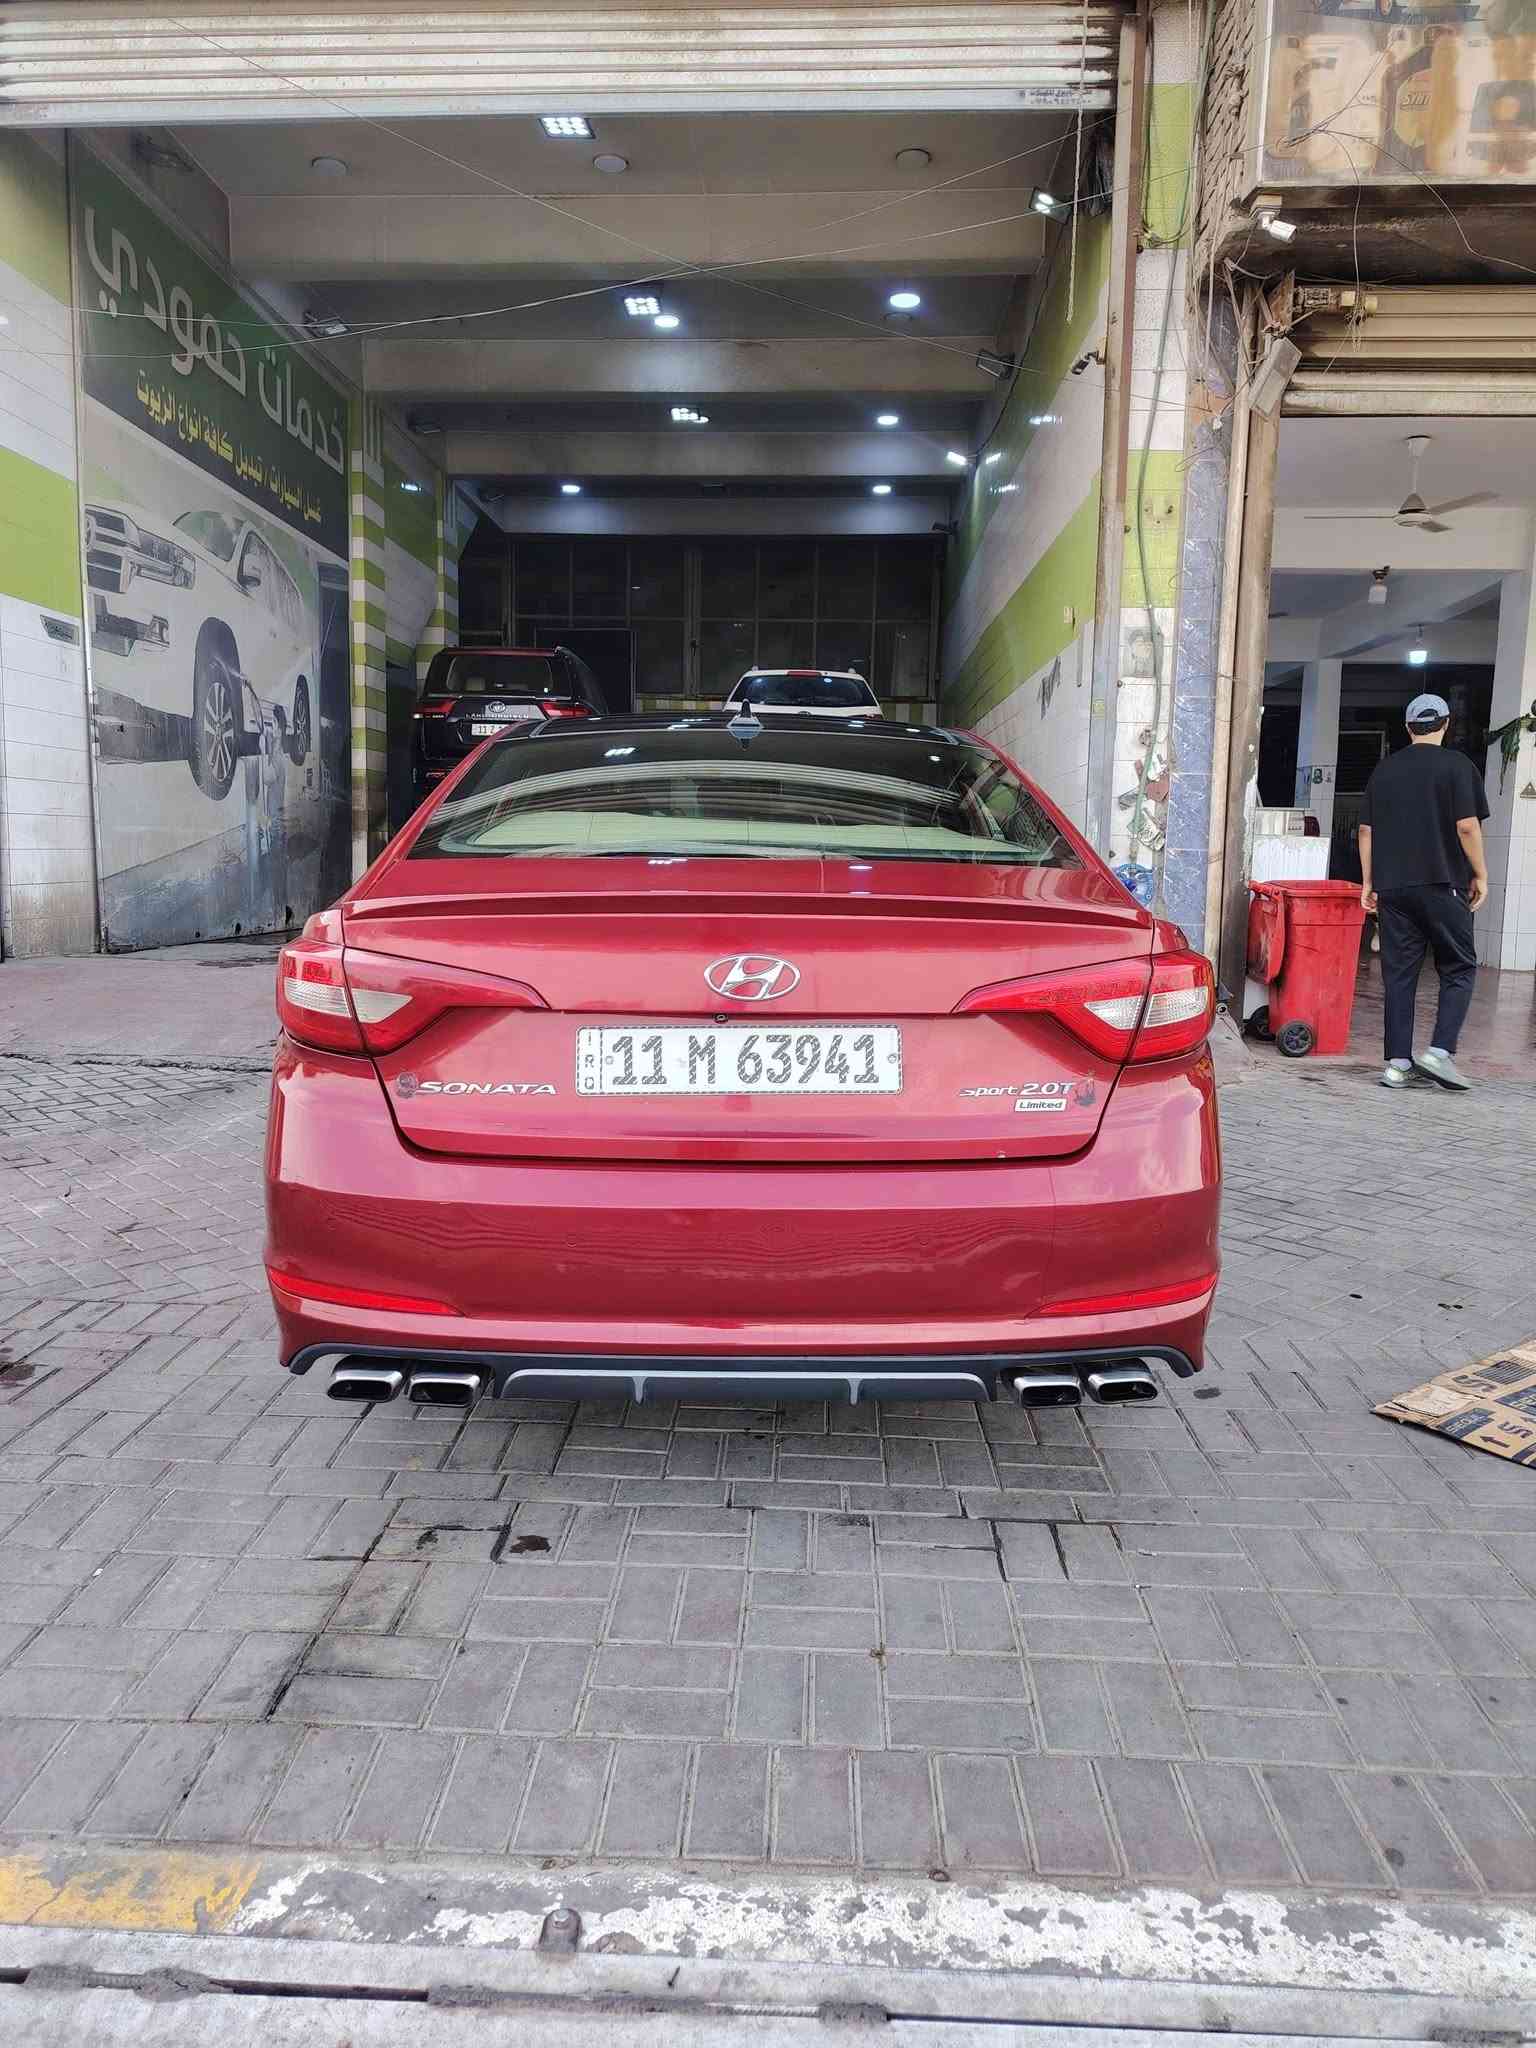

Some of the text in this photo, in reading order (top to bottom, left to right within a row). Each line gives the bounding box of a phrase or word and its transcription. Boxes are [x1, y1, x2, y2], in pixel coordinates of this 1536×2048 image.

[83, 206, 344, 475] خدمات حمودي
[612, 1034, 880, 1086] 11 M 63941
[418, 1081, 557, 1096] SONATA
[1018, 1100, 1063, 1110] Limited
